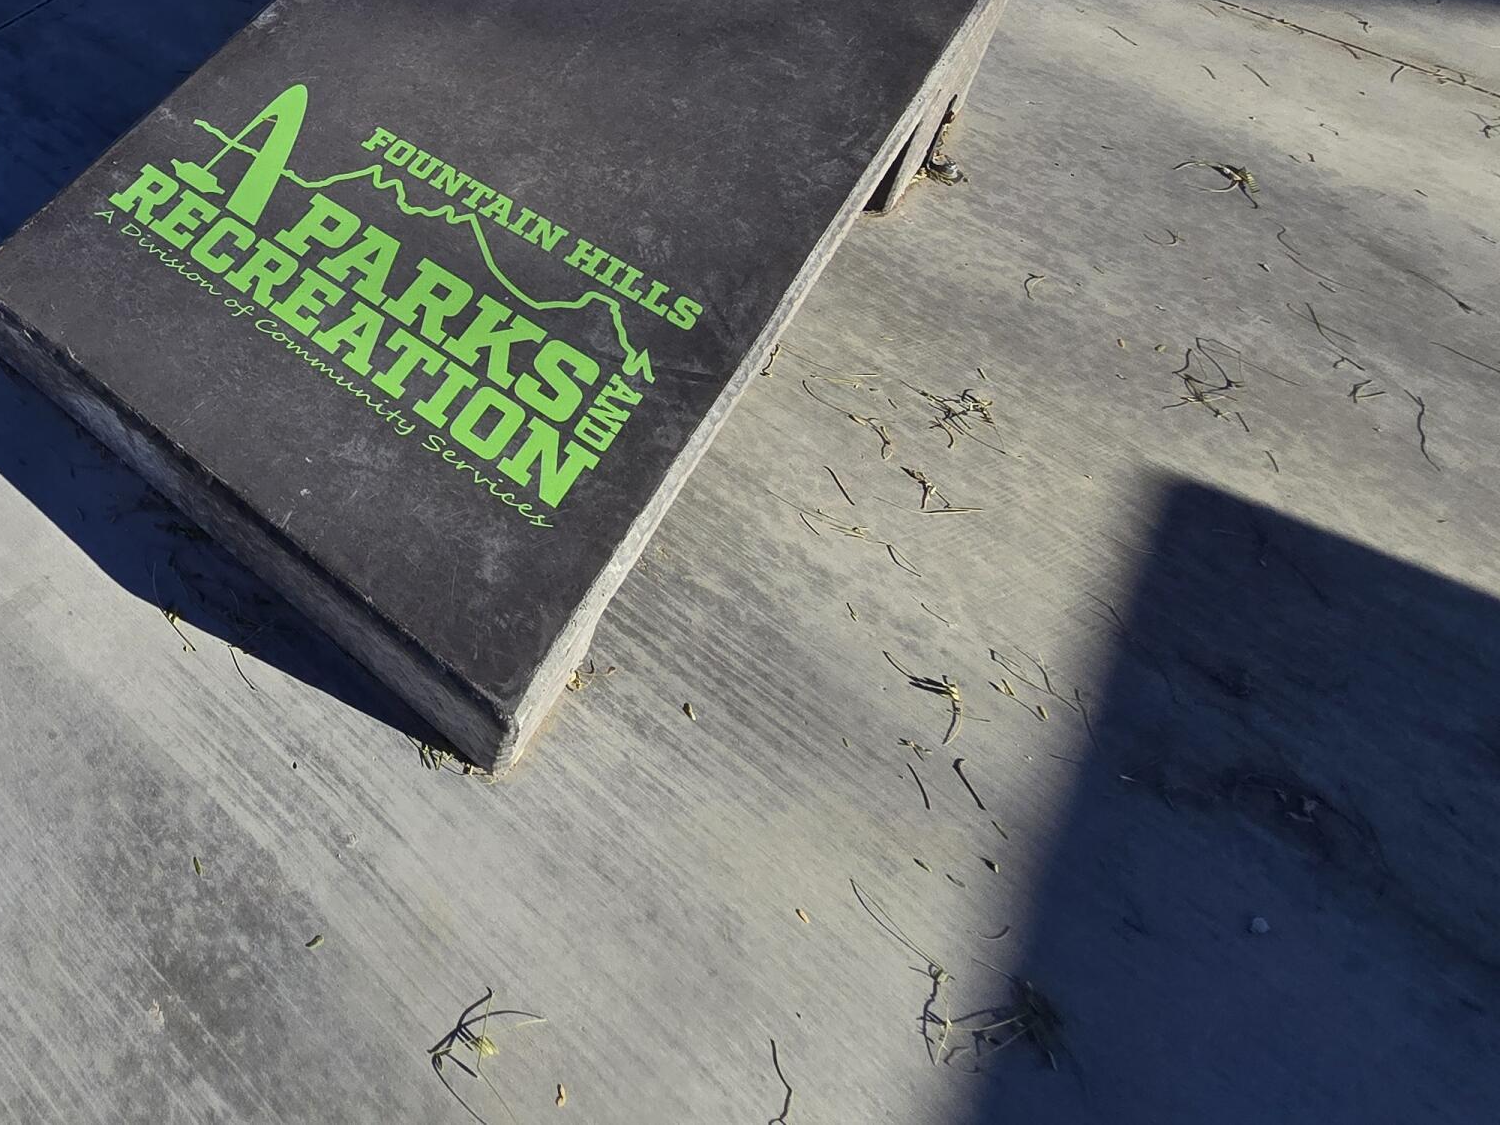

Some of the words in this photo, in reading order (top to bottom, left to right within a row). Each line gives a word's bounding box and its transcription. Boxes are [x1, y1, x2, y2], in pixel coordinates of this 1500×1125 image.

[108, 163, 600, 509] RECREATION
[274, 192, 600, 423] PARKS
[361, 126, 569, 252] FOUNTAIN
[564, 239, 703, 331] HILLS
[94, 209, 116, 224] A
[120, 222, 222, 296] Division
[223, 298, 255, 317] of
[254, 318, 417, 436] Community
[421, 433, 554, 528] Services
[573, 373, 644, 452] AND
